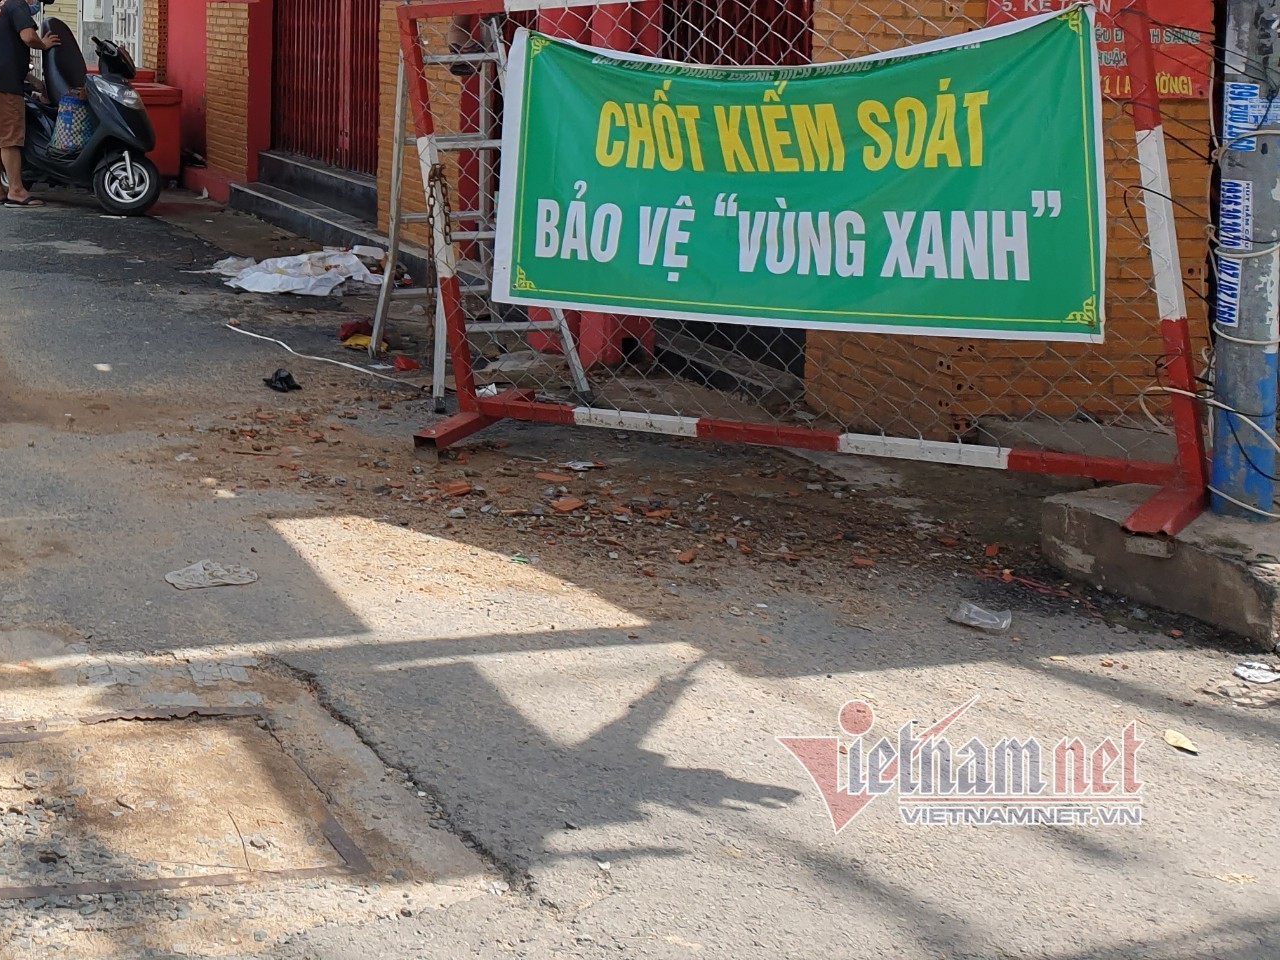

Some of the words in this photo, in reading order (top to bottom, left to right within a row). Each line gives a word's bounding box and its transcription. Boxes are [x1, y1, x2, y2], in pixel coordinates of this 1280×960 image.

[594, 79, 706, 173] CHỐT
[713, 80, 846, 174] KIỂM
[857, 77, 990, 170] SOÁT
[534, 180, 622, 263] BẢO
[639, 194, 696, 283] VỆ
